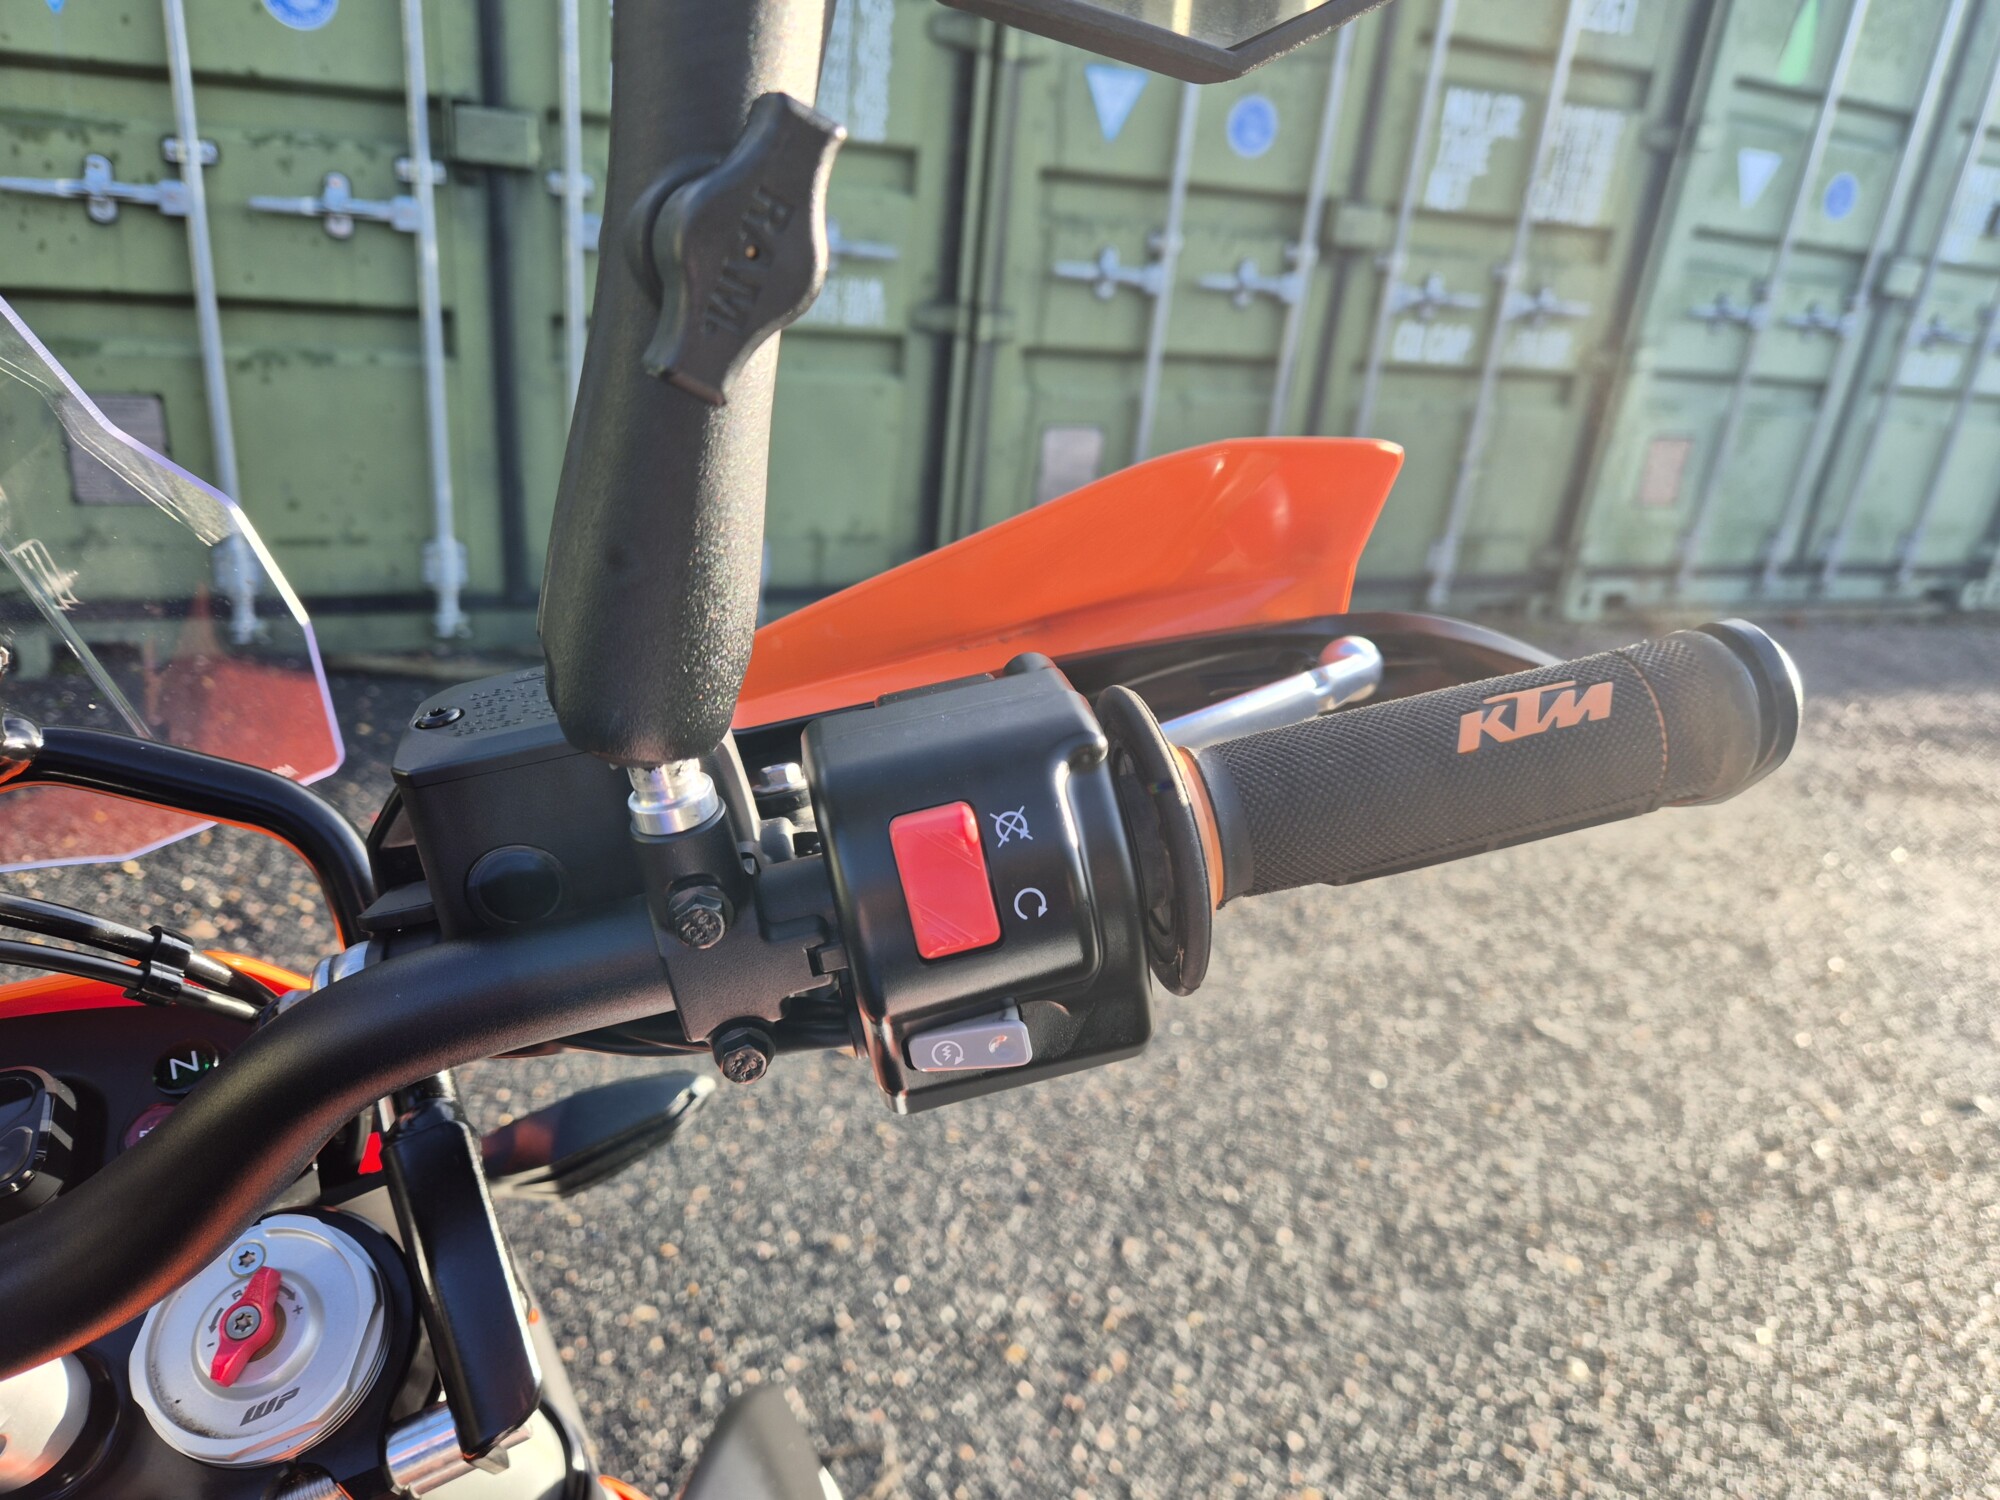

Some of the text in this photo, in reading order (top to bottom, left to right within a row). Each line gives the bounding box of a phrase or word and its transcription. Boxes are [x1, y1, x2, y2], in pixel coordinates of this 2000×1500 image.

[1457, 680, 1613, 753] KTM
[169, 1050, 199, 1080] N
[239, 1387, 300, 1427] WP
